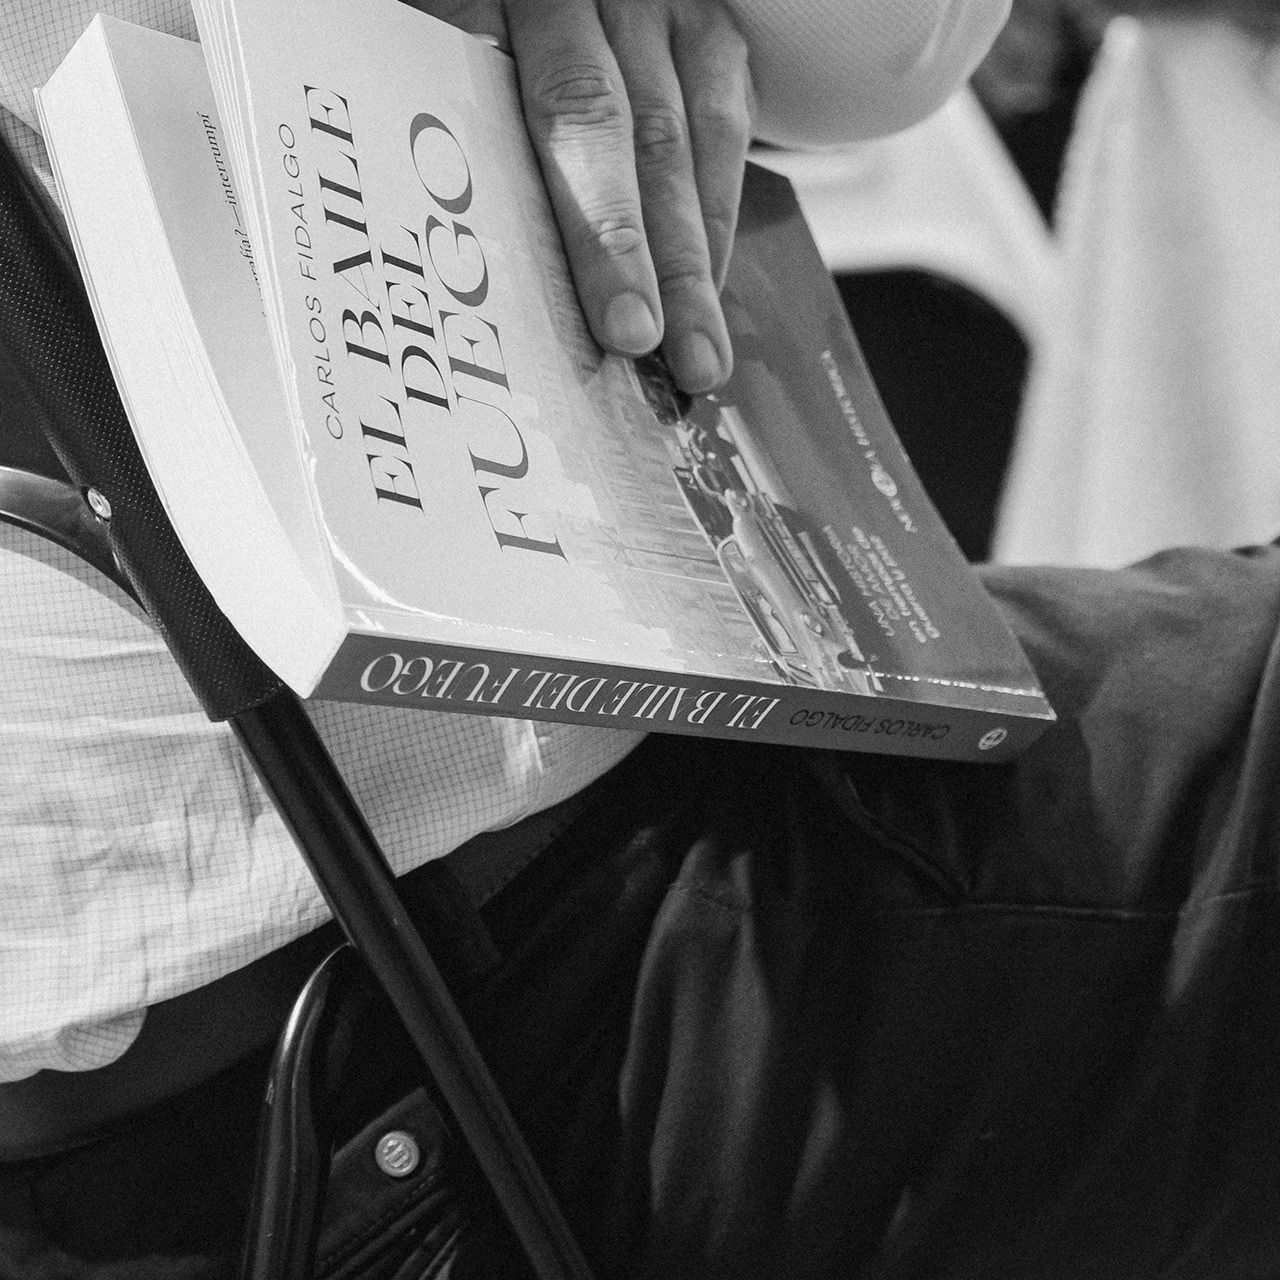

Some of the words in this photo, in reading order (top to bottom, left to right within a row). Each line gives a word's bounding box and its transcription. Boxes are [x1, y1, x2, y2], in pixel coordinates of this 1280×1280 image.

[278, 123, 318, 283] FIDALGO
[303, 84, 392, 372] BAILE
[380, 225, 452, 416] DEL
[409, 112, 570, 565] FUEGO
[304, 294, 343, 440] CARLOS
[358, 395, 425, 516] EL
[359, 652, 521, 705] FUEGO
[521, 669, 605, 716] DEL
[598, 678, 727, 724] BAILE
[726, 694, 782, 730] EL
[789, 709, 870, 734] FIDALGO
[874, 717, 951, 741] CARLOS
